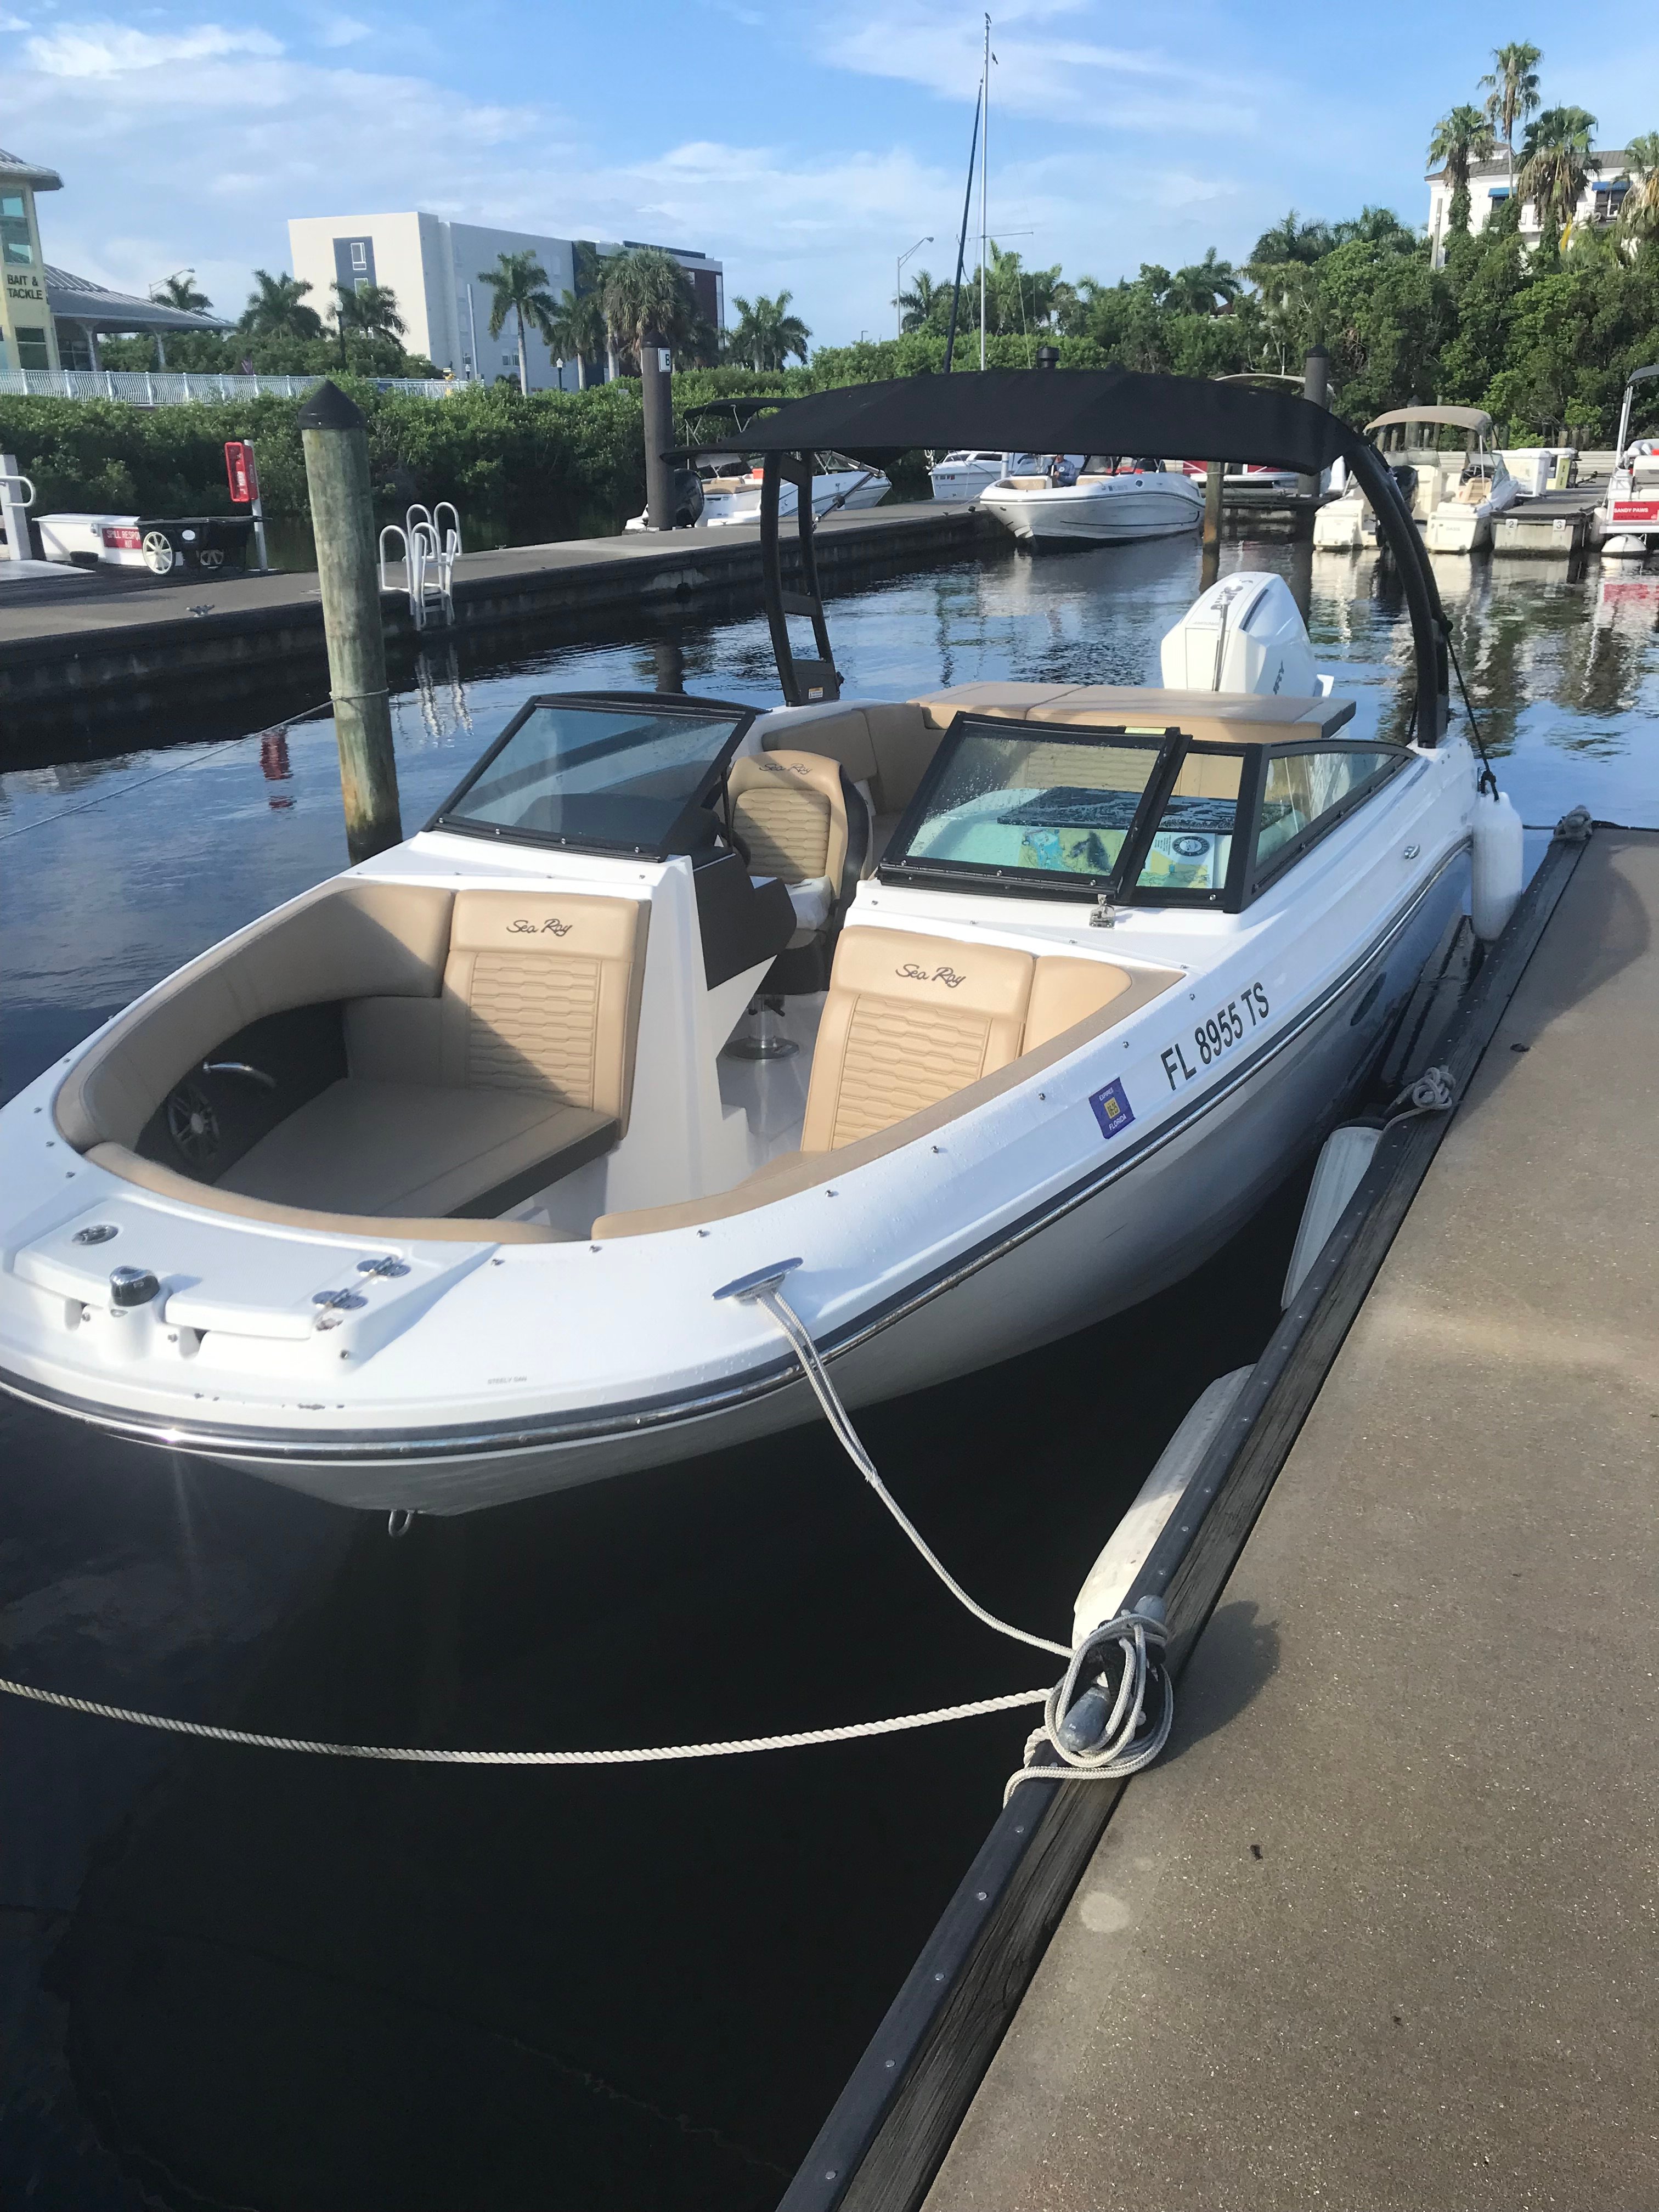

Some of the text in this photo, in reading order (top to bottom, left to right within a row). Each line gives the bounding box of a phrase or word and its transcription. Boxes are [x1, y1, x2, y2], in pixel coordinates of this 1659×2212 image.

[7, 274, 39, 286] BAIT &
[7, 288, 43, 300] TACKLE
[665, 354, 670, 366] B
[1556, 521, 1562, 529] 3
[106, 530, 122, 538] SPILL
[759, 763, 813, 775] Sea Ray
[506, 918, 573, 937] Sea Ray
[895, 963, 967, 988] Sea Ray
[1160, 981, 1269, 1091] FL 8955 TS
[1099, 1087, 1114, 1101] EXPIRES
[1109, 1113, 1127, 1131] FLORIDA
